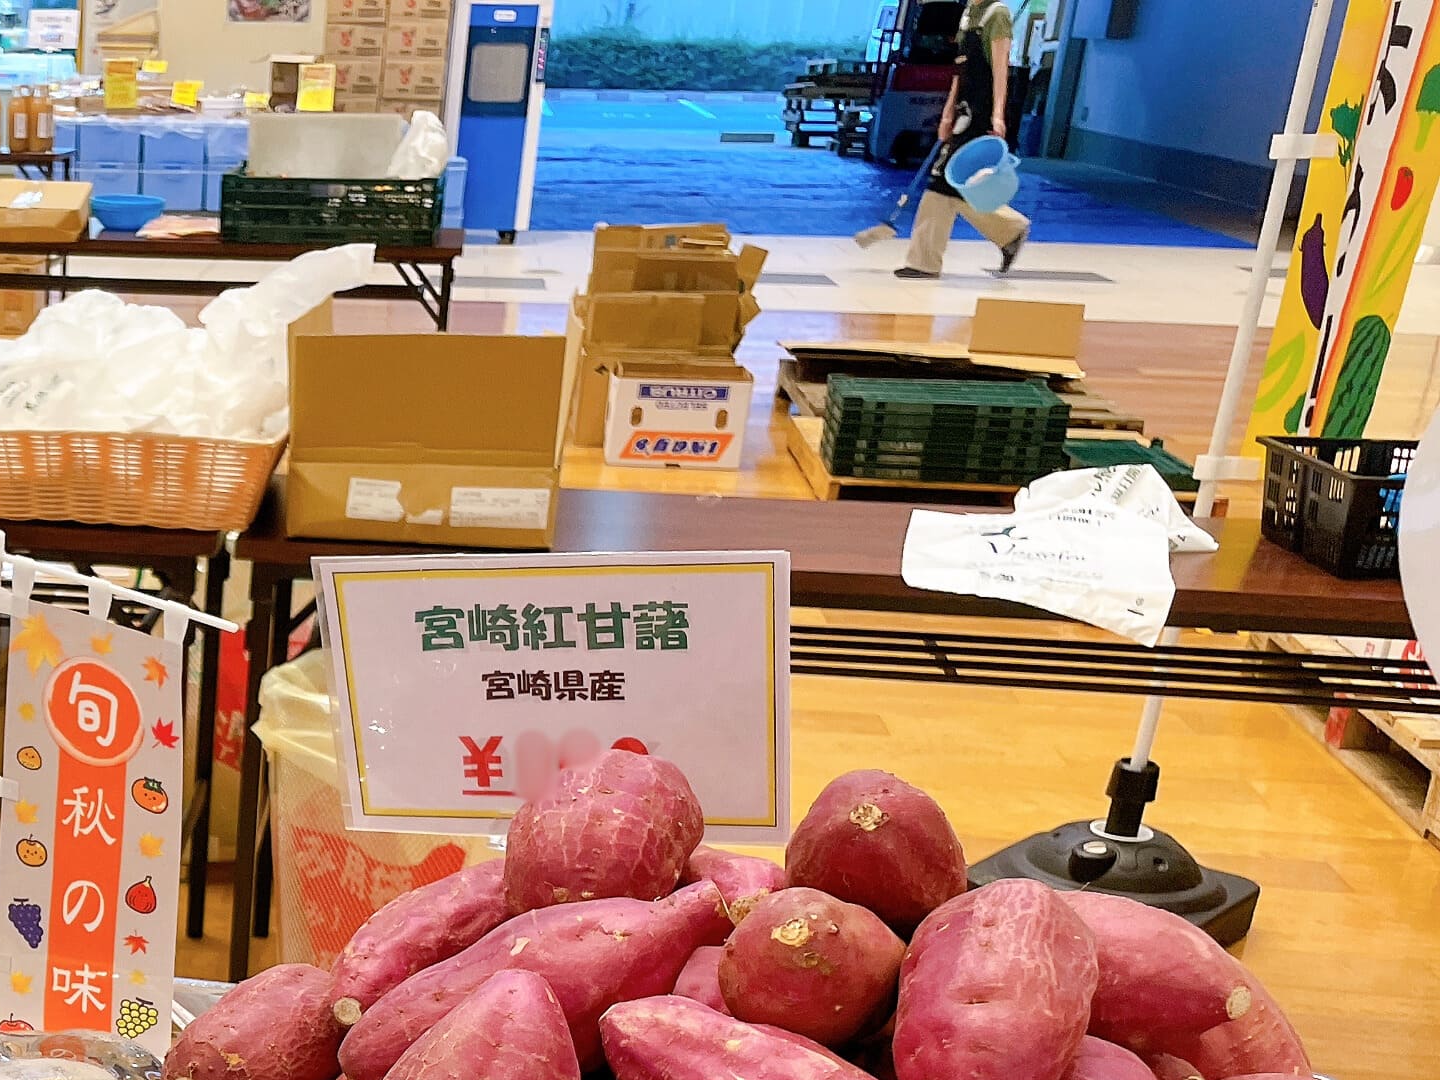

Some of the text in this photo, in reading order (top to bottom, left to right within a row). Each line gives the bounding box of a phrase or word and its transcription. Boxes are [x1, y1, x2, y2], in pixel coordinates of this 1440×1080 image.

[414, 600, 690, 652] 宮崎紅甘藷
[68, 671, 119, 747] 旬
[481, 669, 626, 702] 宮崎県産
[51, 785, 117, 1014] 秋の味
